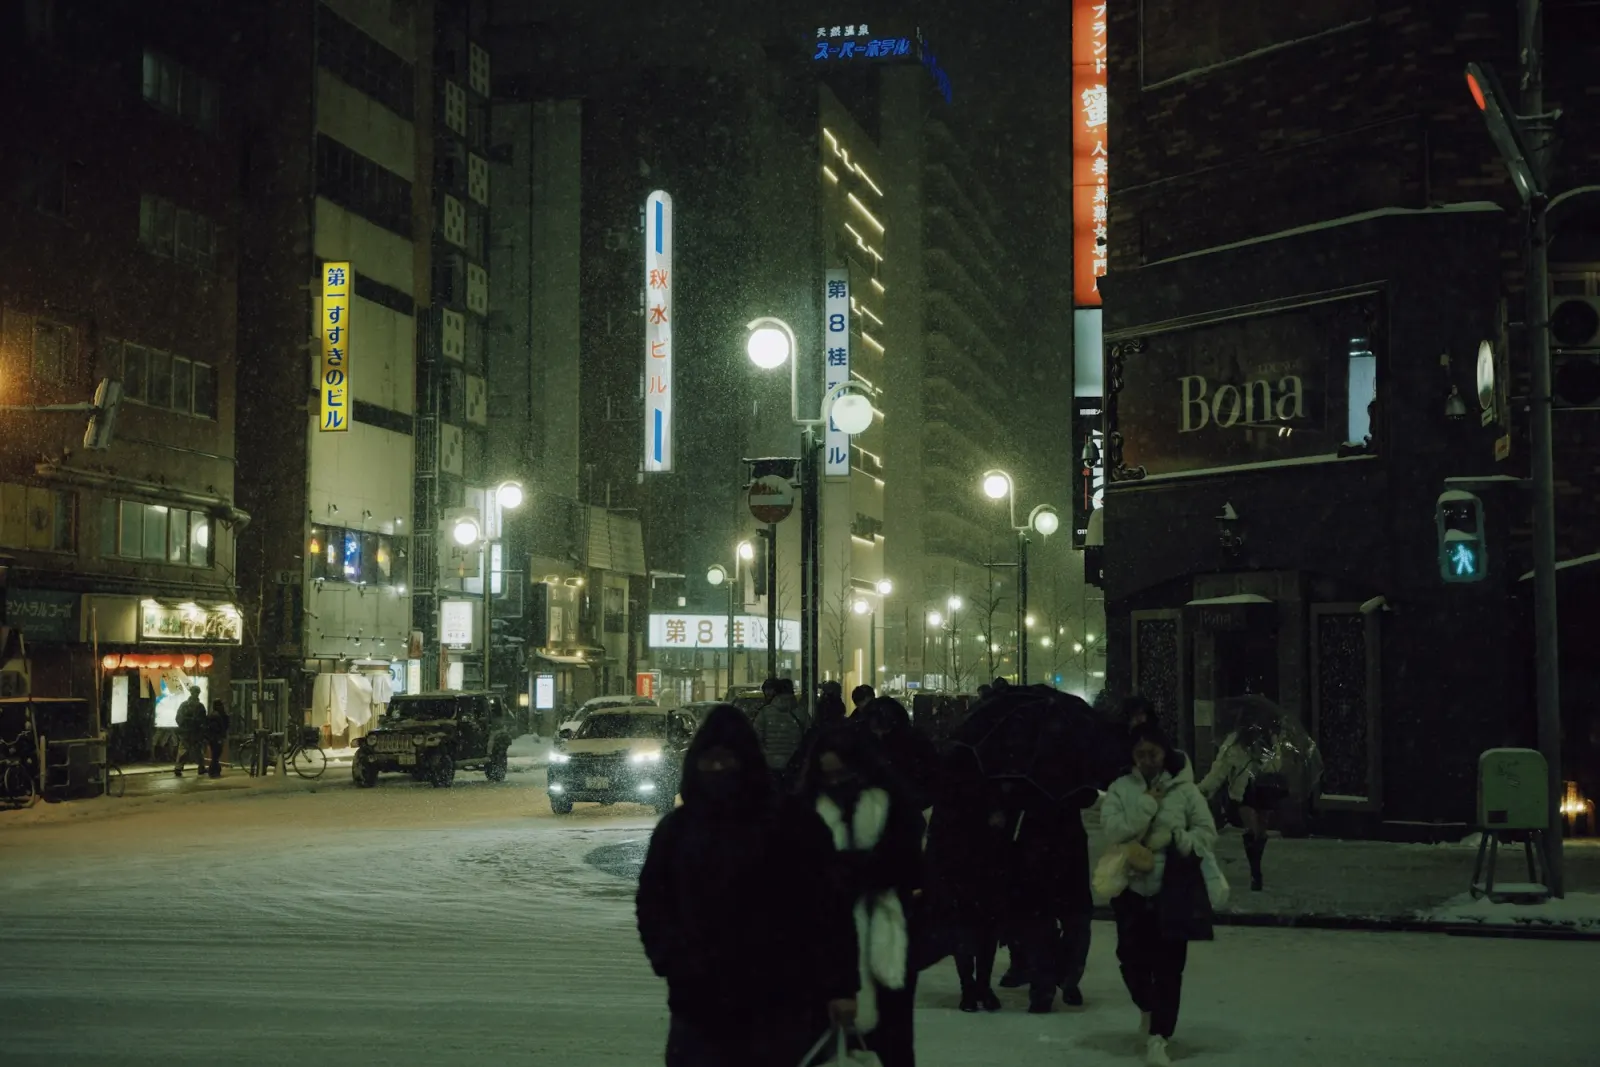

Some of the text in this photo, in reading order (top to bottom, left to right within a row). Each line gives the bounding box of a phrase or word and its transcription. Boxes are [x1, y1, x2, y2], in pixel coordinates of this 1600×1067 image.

[815, 37, 912, 60] スーパーホテル
[817, 24, 869, 38] 天然温泉
[325, 267, 345, 428] 第一すすきのビル
[649, 268, 669, 394] 秋水ビル
[1177, 375, 1305, 433] Bona
